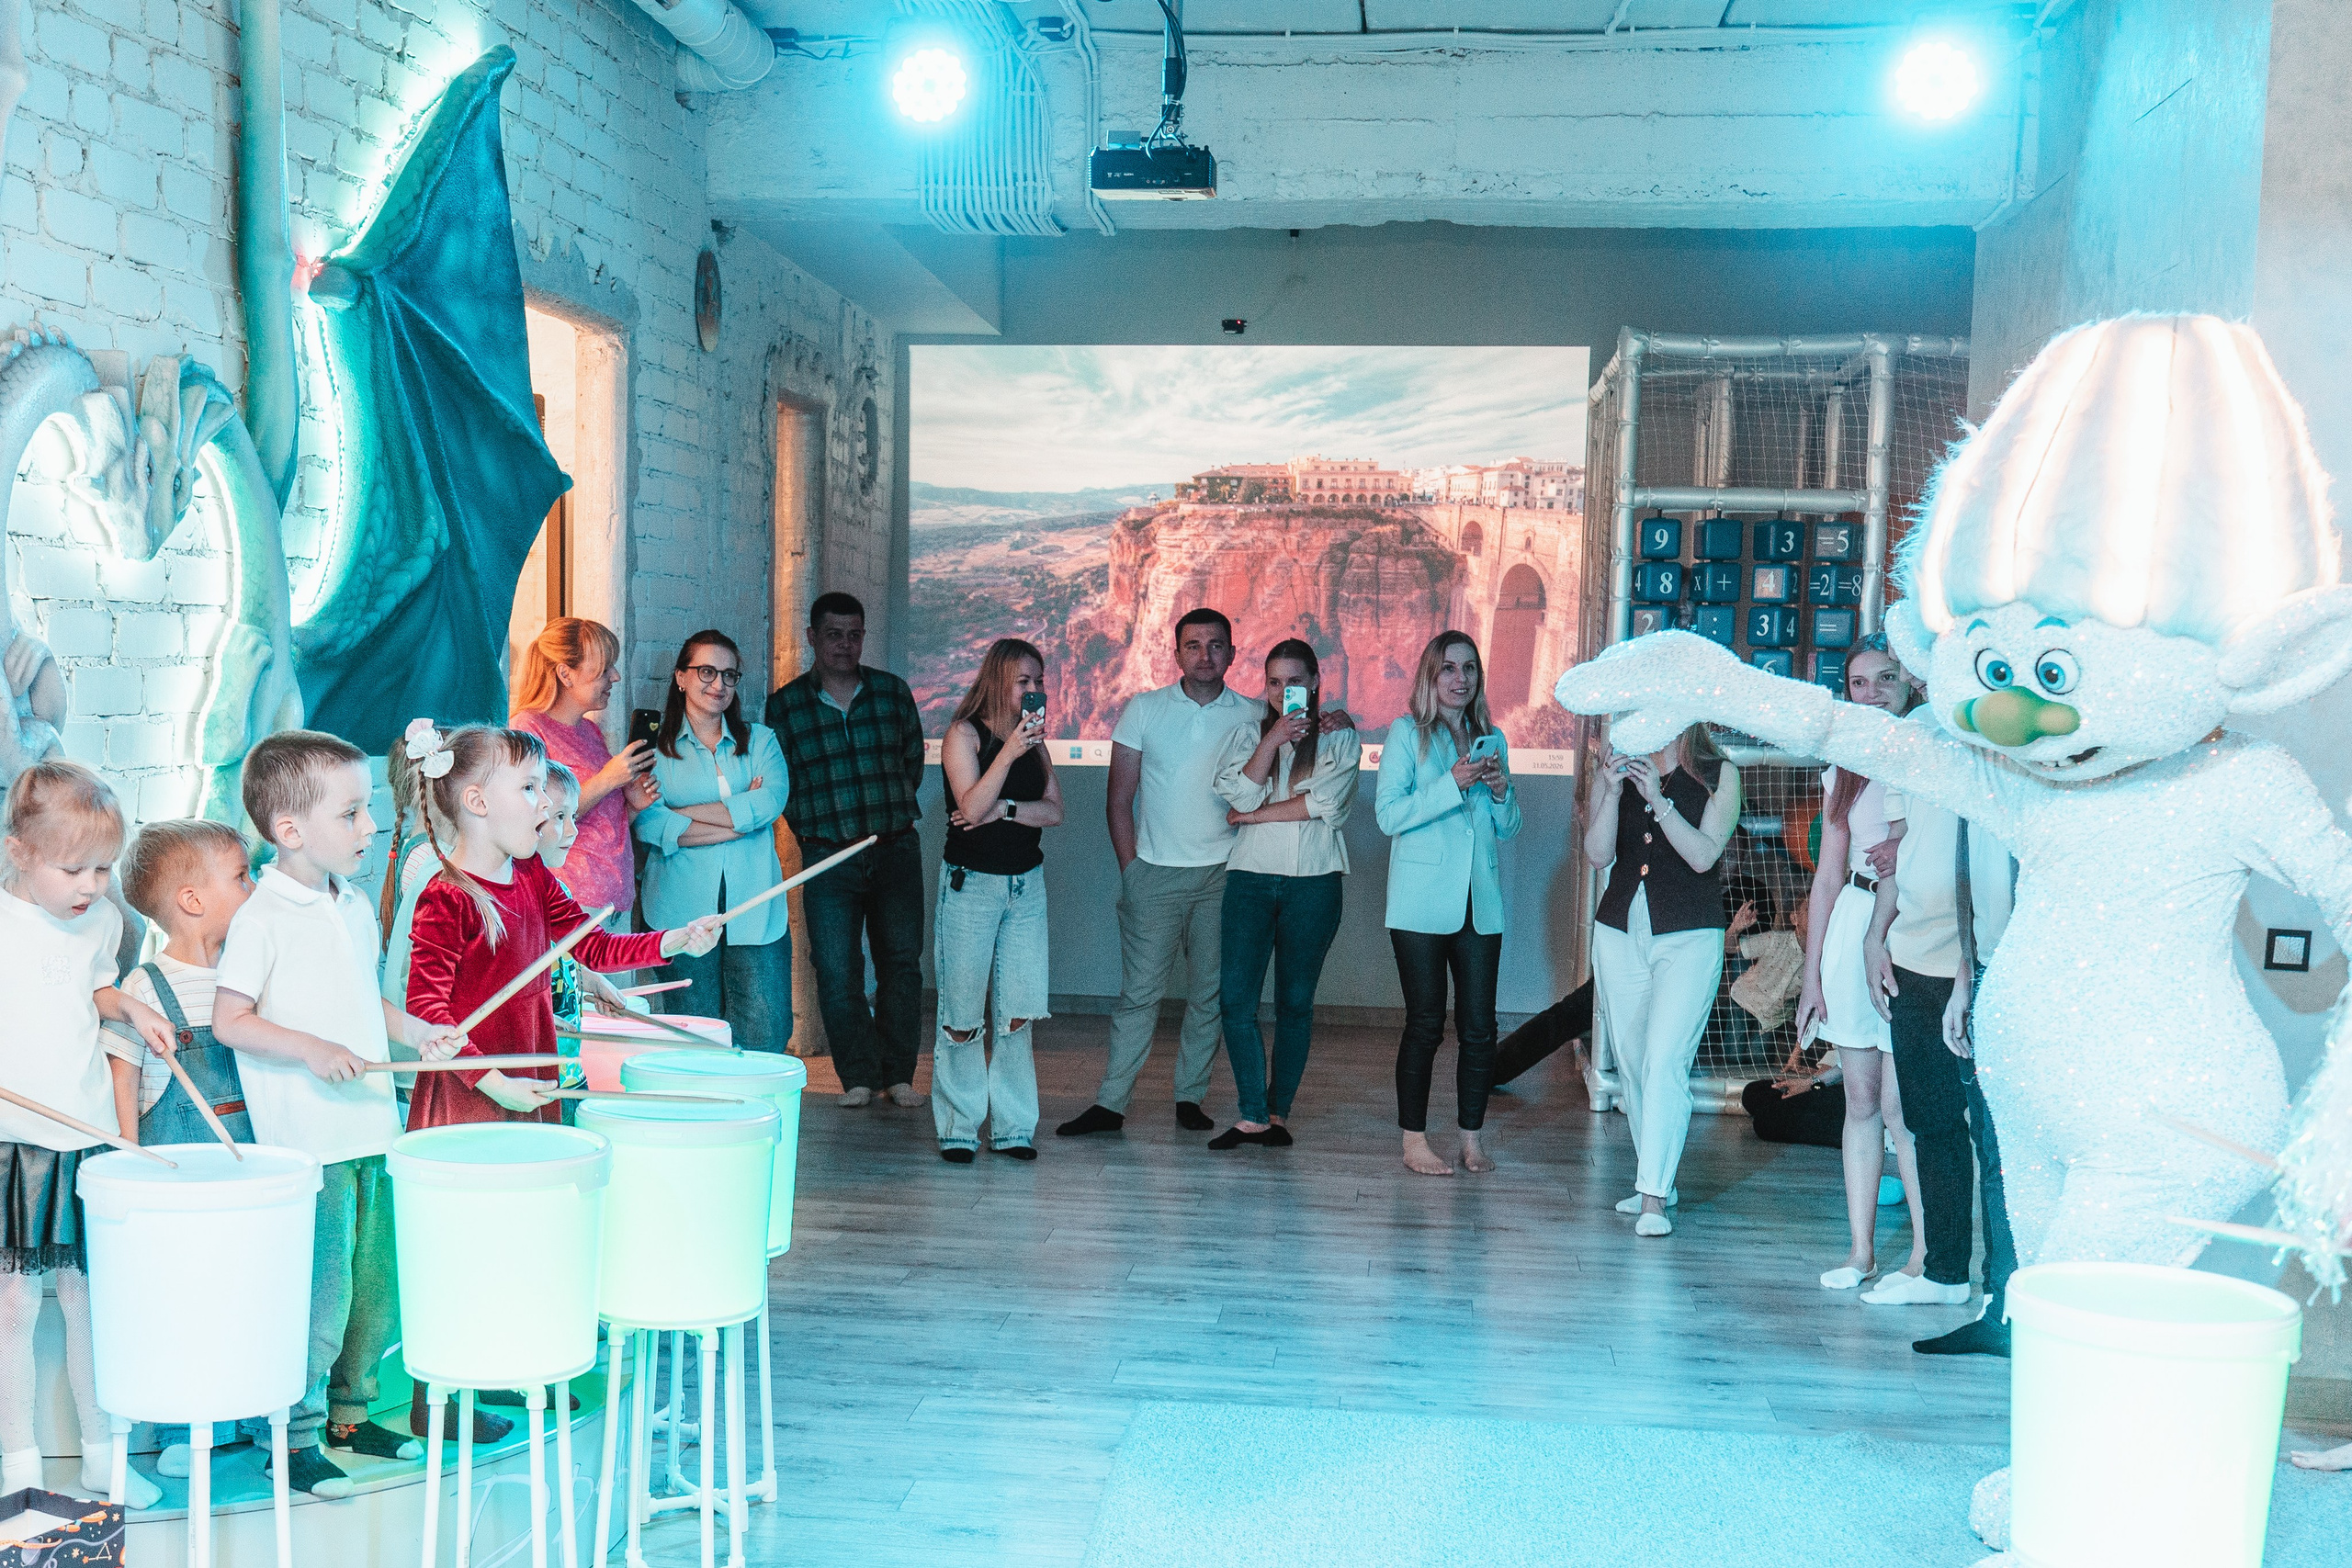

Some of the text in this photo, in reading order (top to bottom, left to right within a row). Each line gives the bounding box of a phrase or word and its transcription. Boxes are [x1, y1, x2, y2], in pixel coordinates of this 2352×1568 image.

[1654, 529, 1668, 550] 9
[1781, 530, 1794, 553] 3
[1659, 571, 1673, 594] 8
[1761, 570, 1775, 592] 4
[1642, 613, 1655, 634] 2
[1756, 614, 1770, 637] 3
[1786, 616, 1795, 638] 4
